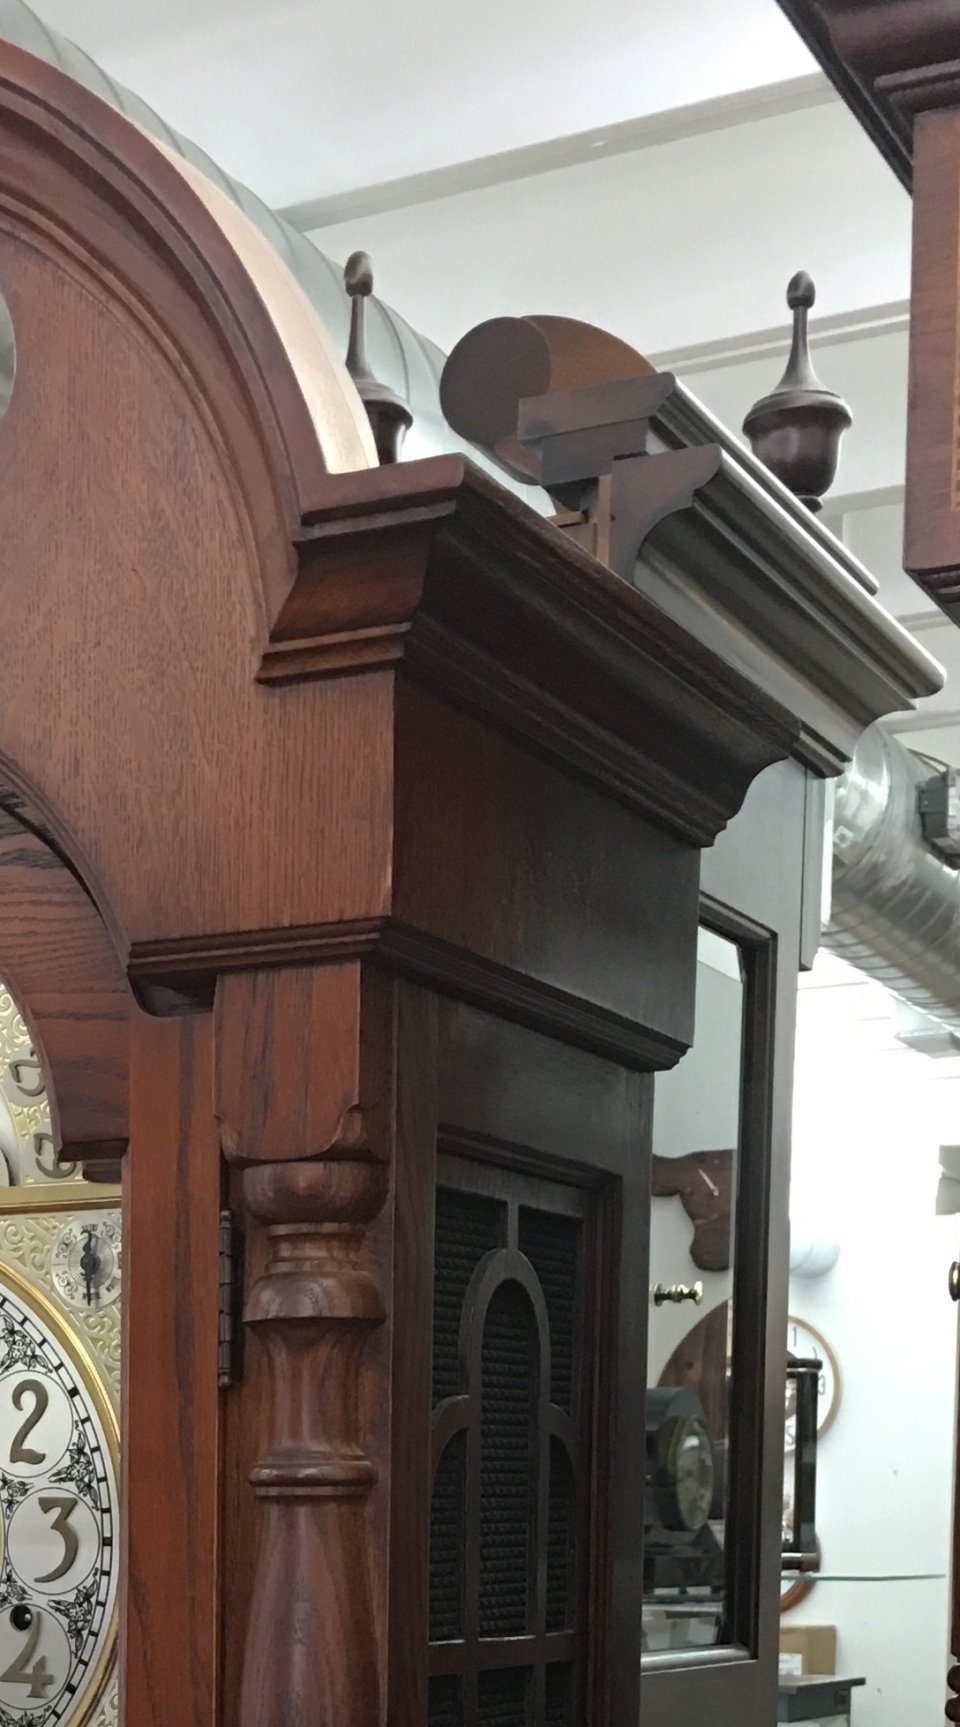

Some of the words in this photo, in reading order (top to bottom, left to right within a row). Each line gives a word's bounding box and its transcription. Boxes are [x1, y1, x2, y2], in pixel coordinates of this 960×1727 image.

[10, 1378, 49, 1465] 2
[35, 1496, 80, 1584] 3
[0, 1606, 54, 1700] 4
